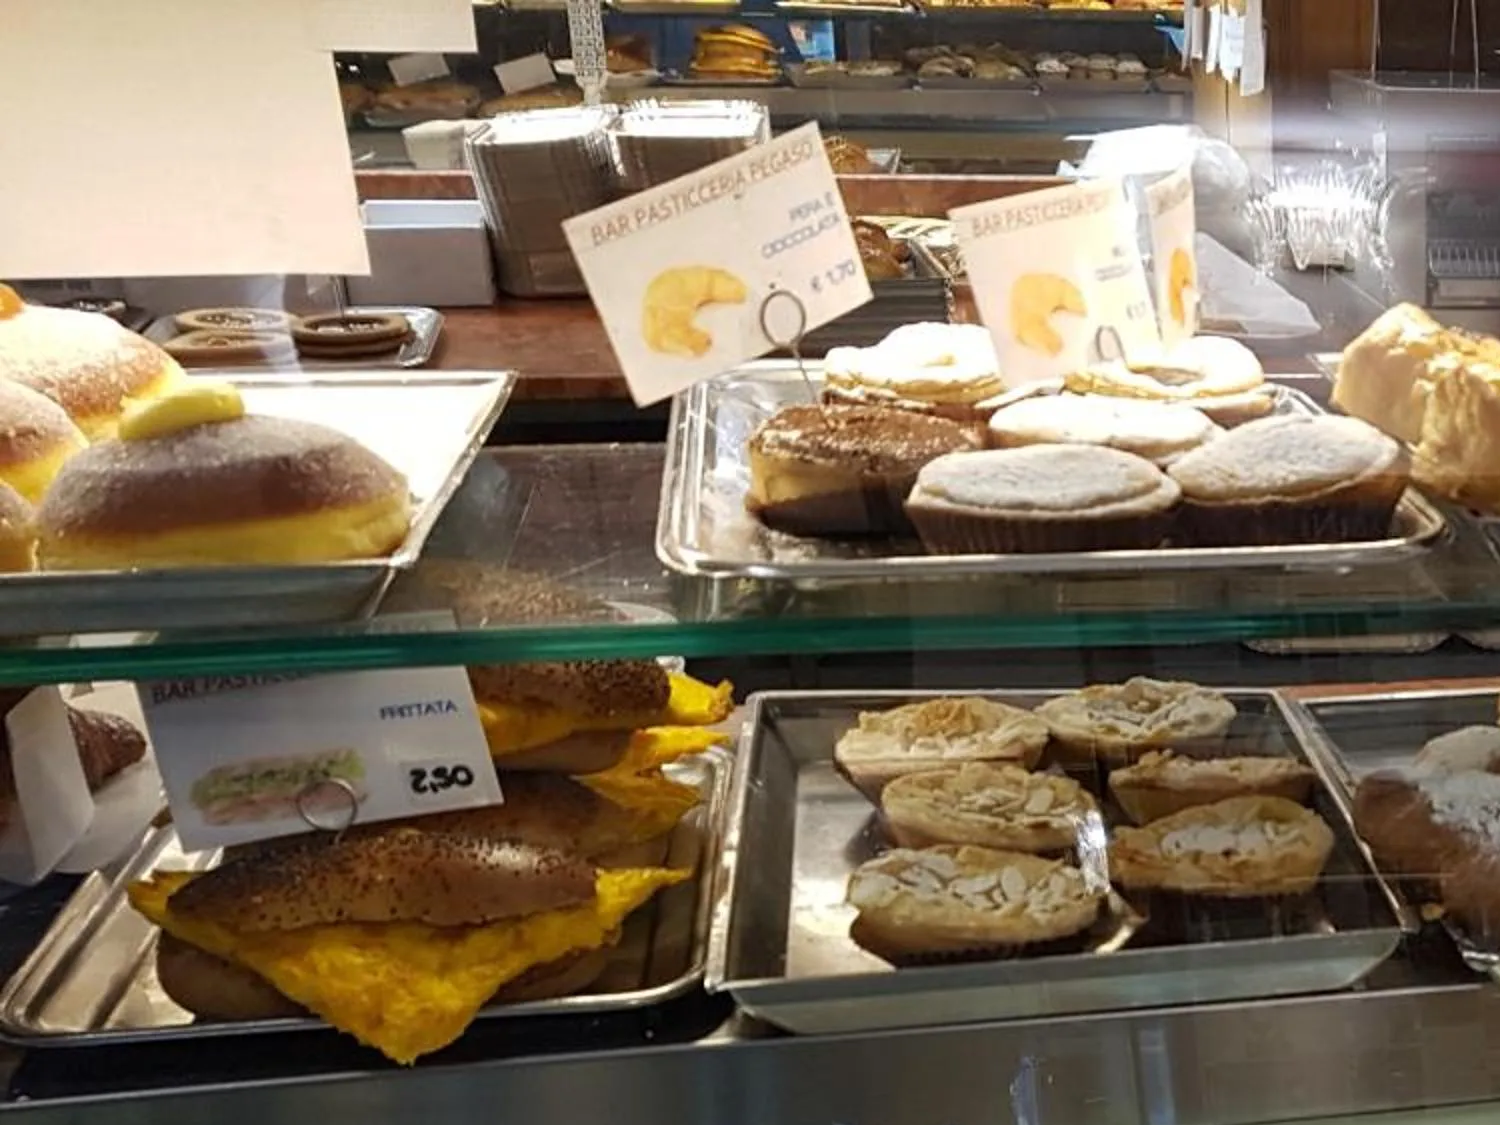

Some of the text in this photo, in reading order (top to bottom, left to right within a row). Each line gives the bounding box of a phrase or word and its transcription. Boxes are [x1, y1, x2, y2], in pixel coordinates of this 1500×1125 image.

[591, 140, 813, 246] BAR PASTICCERIA PEGASO
[380, 699, 458, 720] FRITTATA
